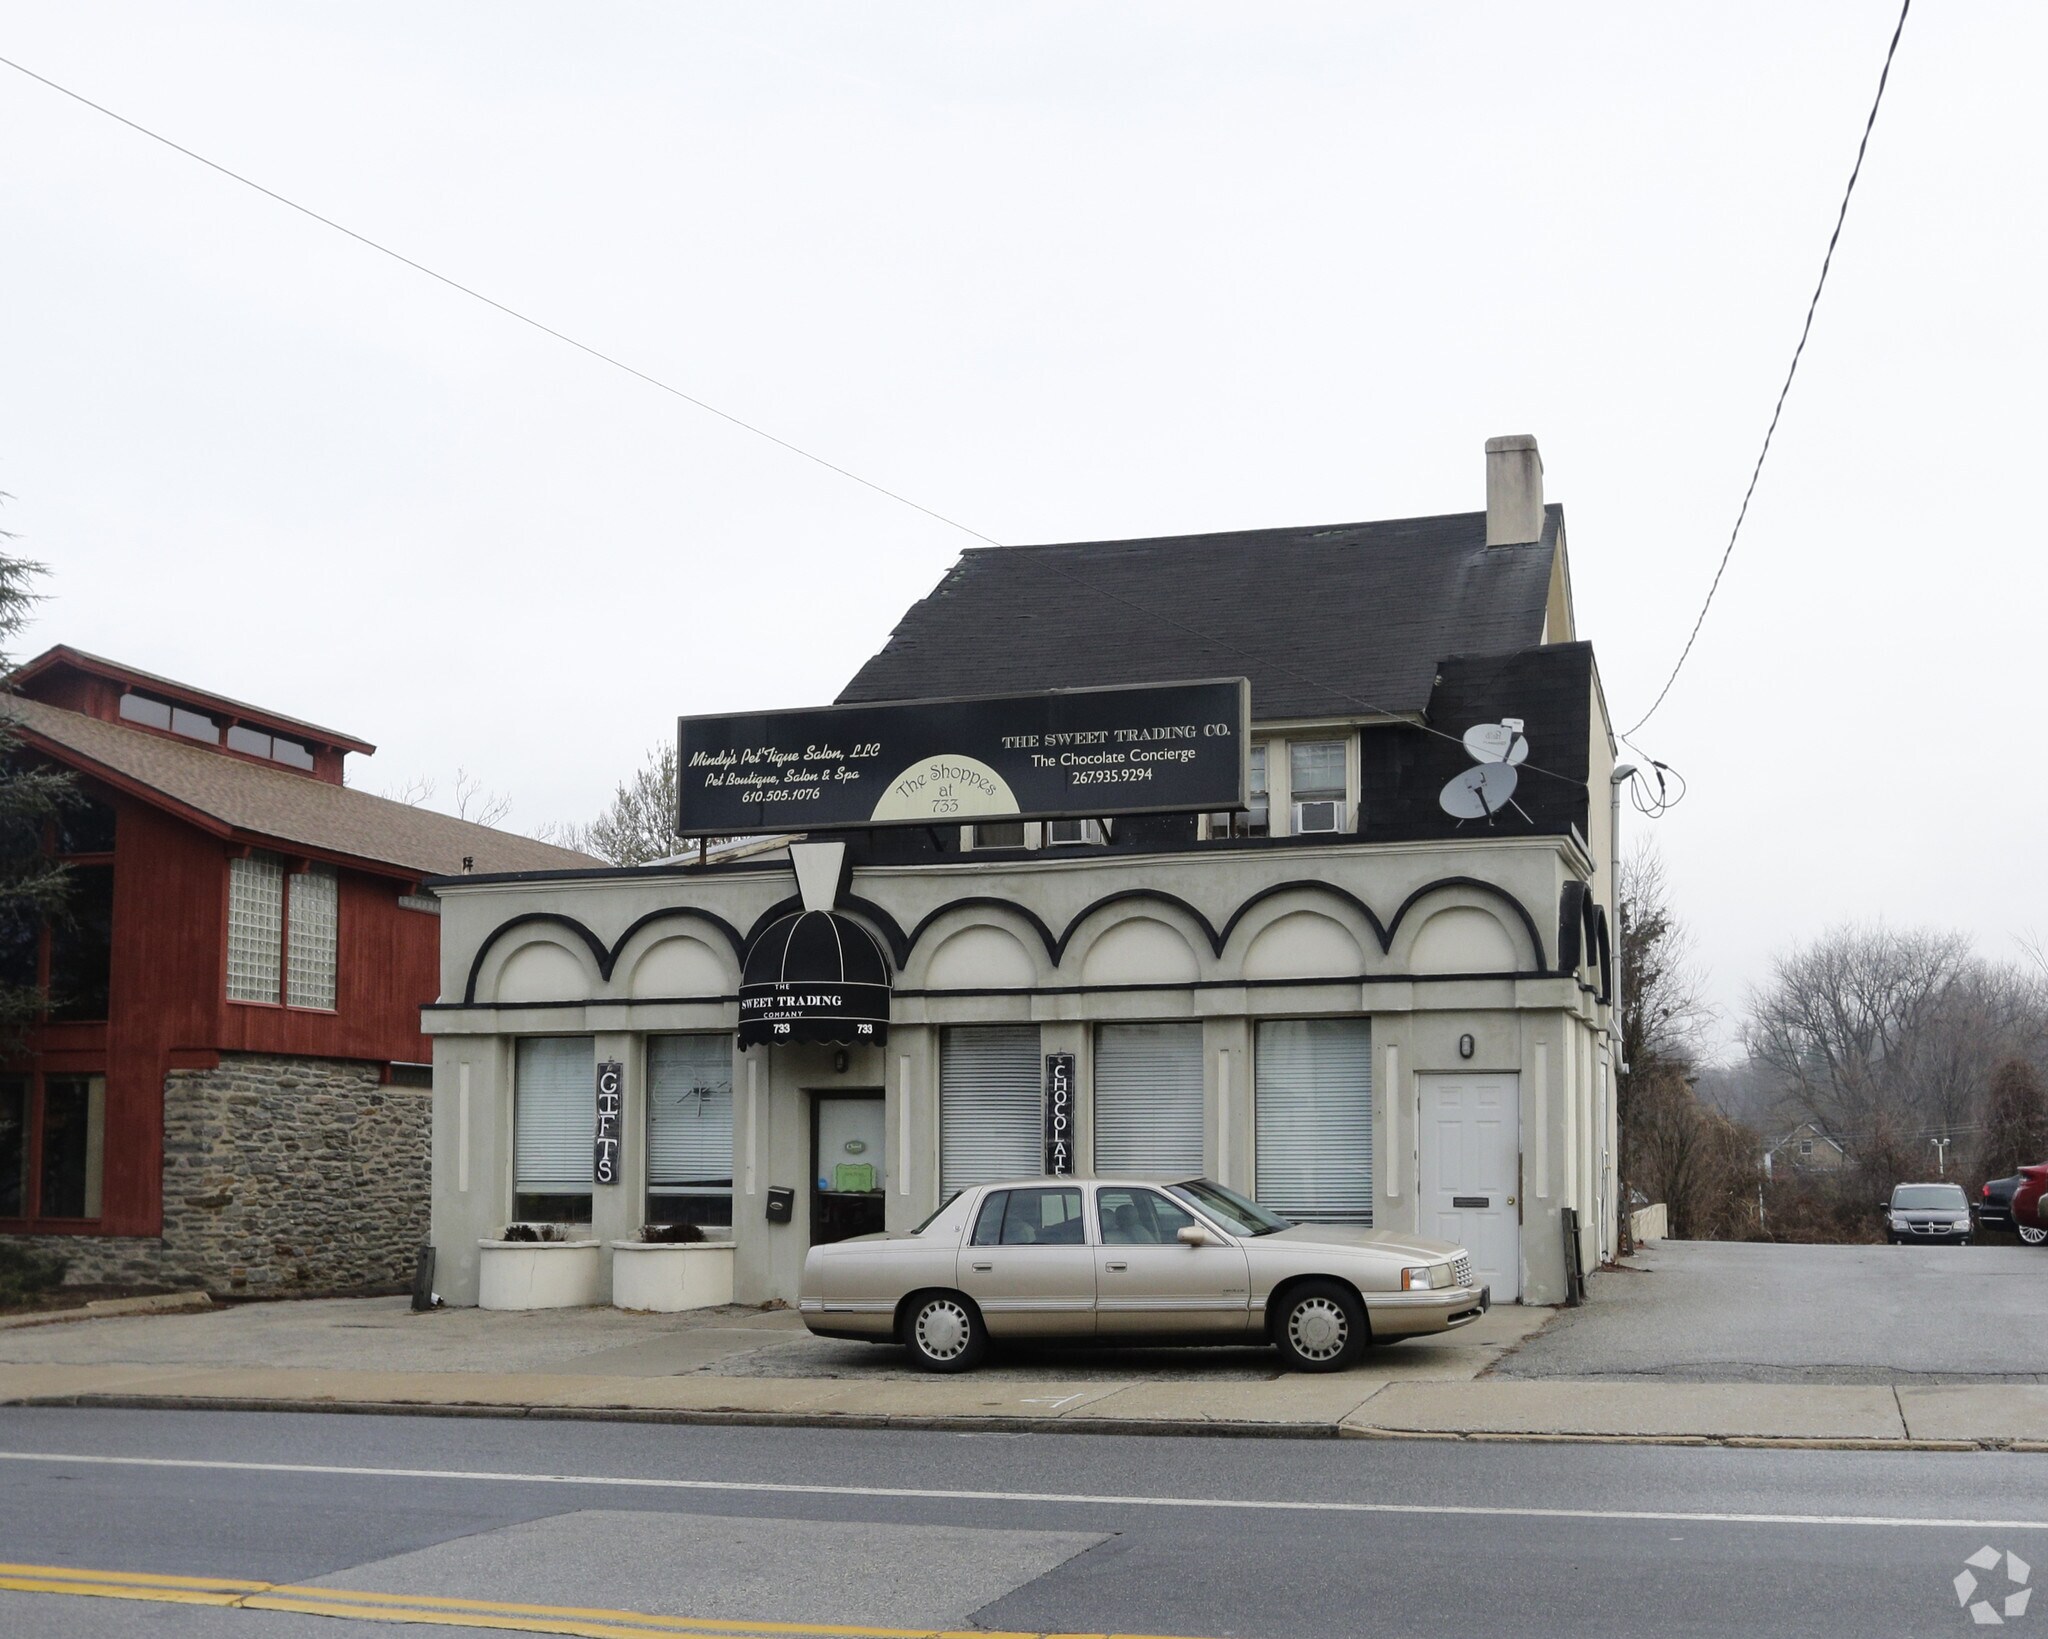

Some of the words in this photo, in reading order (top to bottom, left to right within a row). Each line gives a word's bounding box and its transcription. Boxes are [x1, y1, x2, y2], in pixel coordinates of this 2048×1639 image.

[1002, 735, 1039, 749] THE
[1044, 731, 1108, 747] SWEET
[1114, 725, 1196, 742] TRADING
[1203, 723, 1231, 737] CO.
[688, 749, 738, 771] Mindy's
[803, 743, 845, 761] Salon,
[849, 743, 881, 758] LLC
[1031, 754, 1056, 768] The
[1060, 751, 1125, 766] Chocolate
[1129, 748, 1196, 763] Concierge
[704, 773, 725, 788] Pet
[725, 771, 780, 789] Boutique,
[784, 768, 818, 783] Salon
[821, 770, 830, 781] &
[834, 766, 860, 784] Spa
[895, 774, 927, 798] The
[930, 763, 997, 796] Shoppes
[1072, 768, 1153, 785] 267.935.9294
[742, 787, 820, 803] 610.505.1076
[939, 783, 953, 797] at
[932, 799, 959, 813] 733
[741, 997, 774, 1010] SWEET
[777, 995, 842, 1007] TRADING
[763, 1010, 803, 1018] COMPANY
[773, 1023, 791, 1034] 733
[857, 1023, 873, 1034] 733
[597, 1072, 619, 1182] GIFTS
